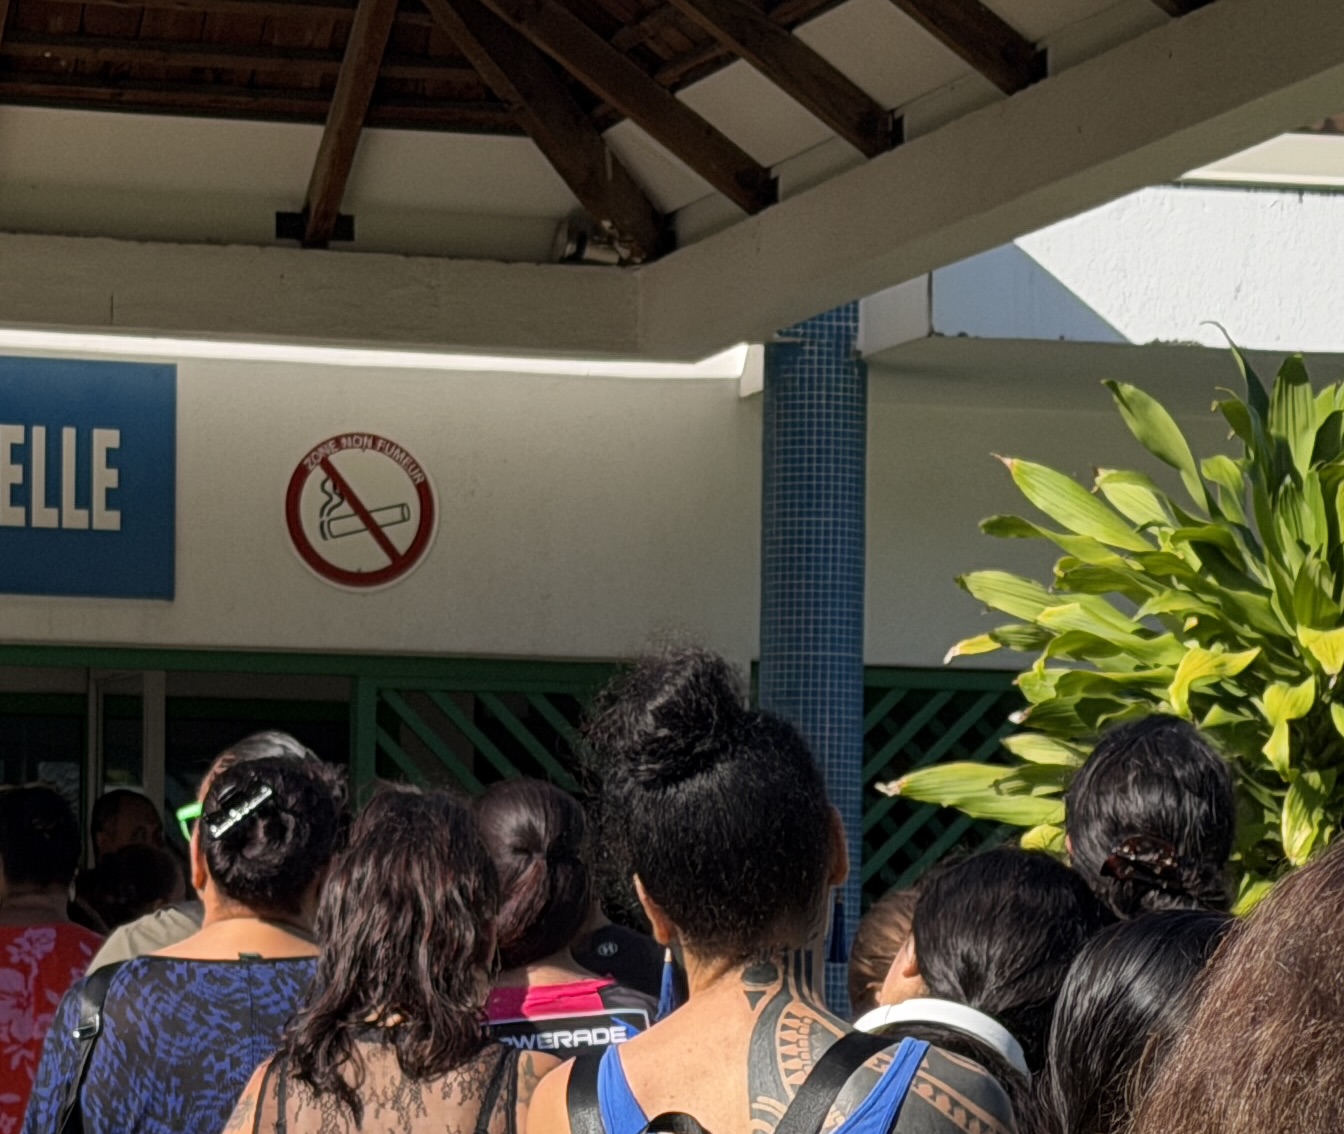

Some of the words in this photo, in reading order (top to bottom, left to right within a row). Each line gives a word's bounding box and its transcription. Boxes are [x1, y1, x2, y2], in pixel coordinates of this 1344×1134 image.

[304, 439, 338, 471] ZONE
[341, 435, 373, 449] NON
[377, 439, 425, 484] FUMEUR
